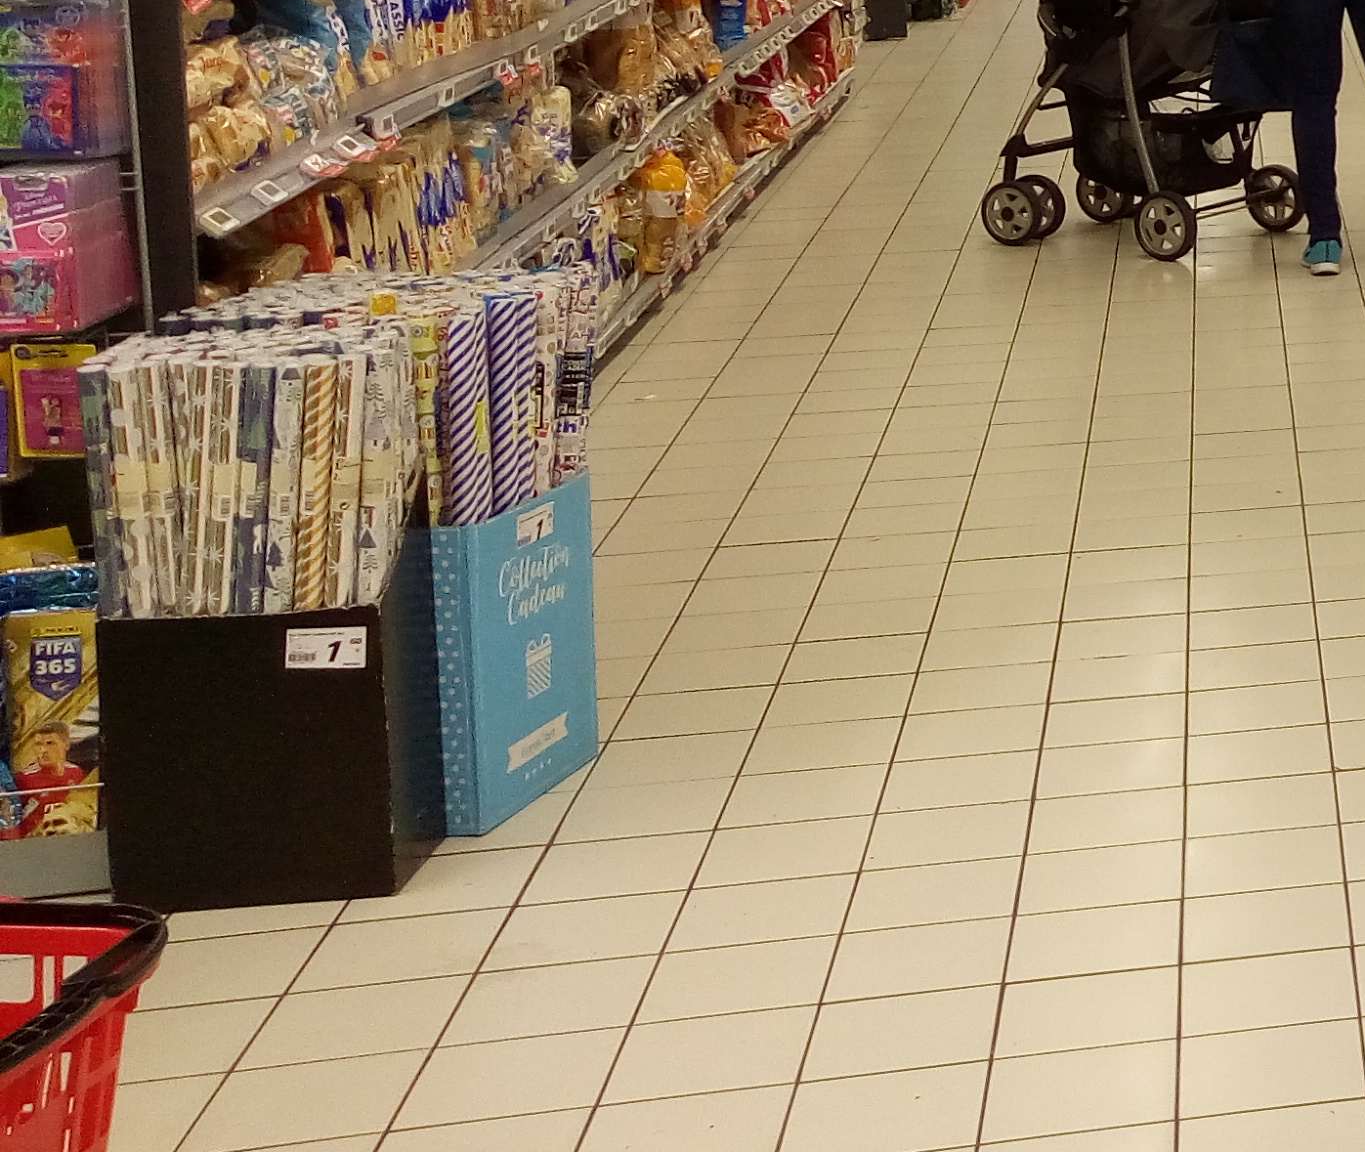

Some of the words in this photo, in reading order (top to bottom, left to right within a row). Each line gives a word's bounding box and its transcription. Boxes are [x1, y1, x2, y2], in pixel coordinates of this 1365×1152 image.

[35, 641, 76, 656] FIFA
[327, 640, 342, 663] 1
[35, 658, 76, 675] 365
